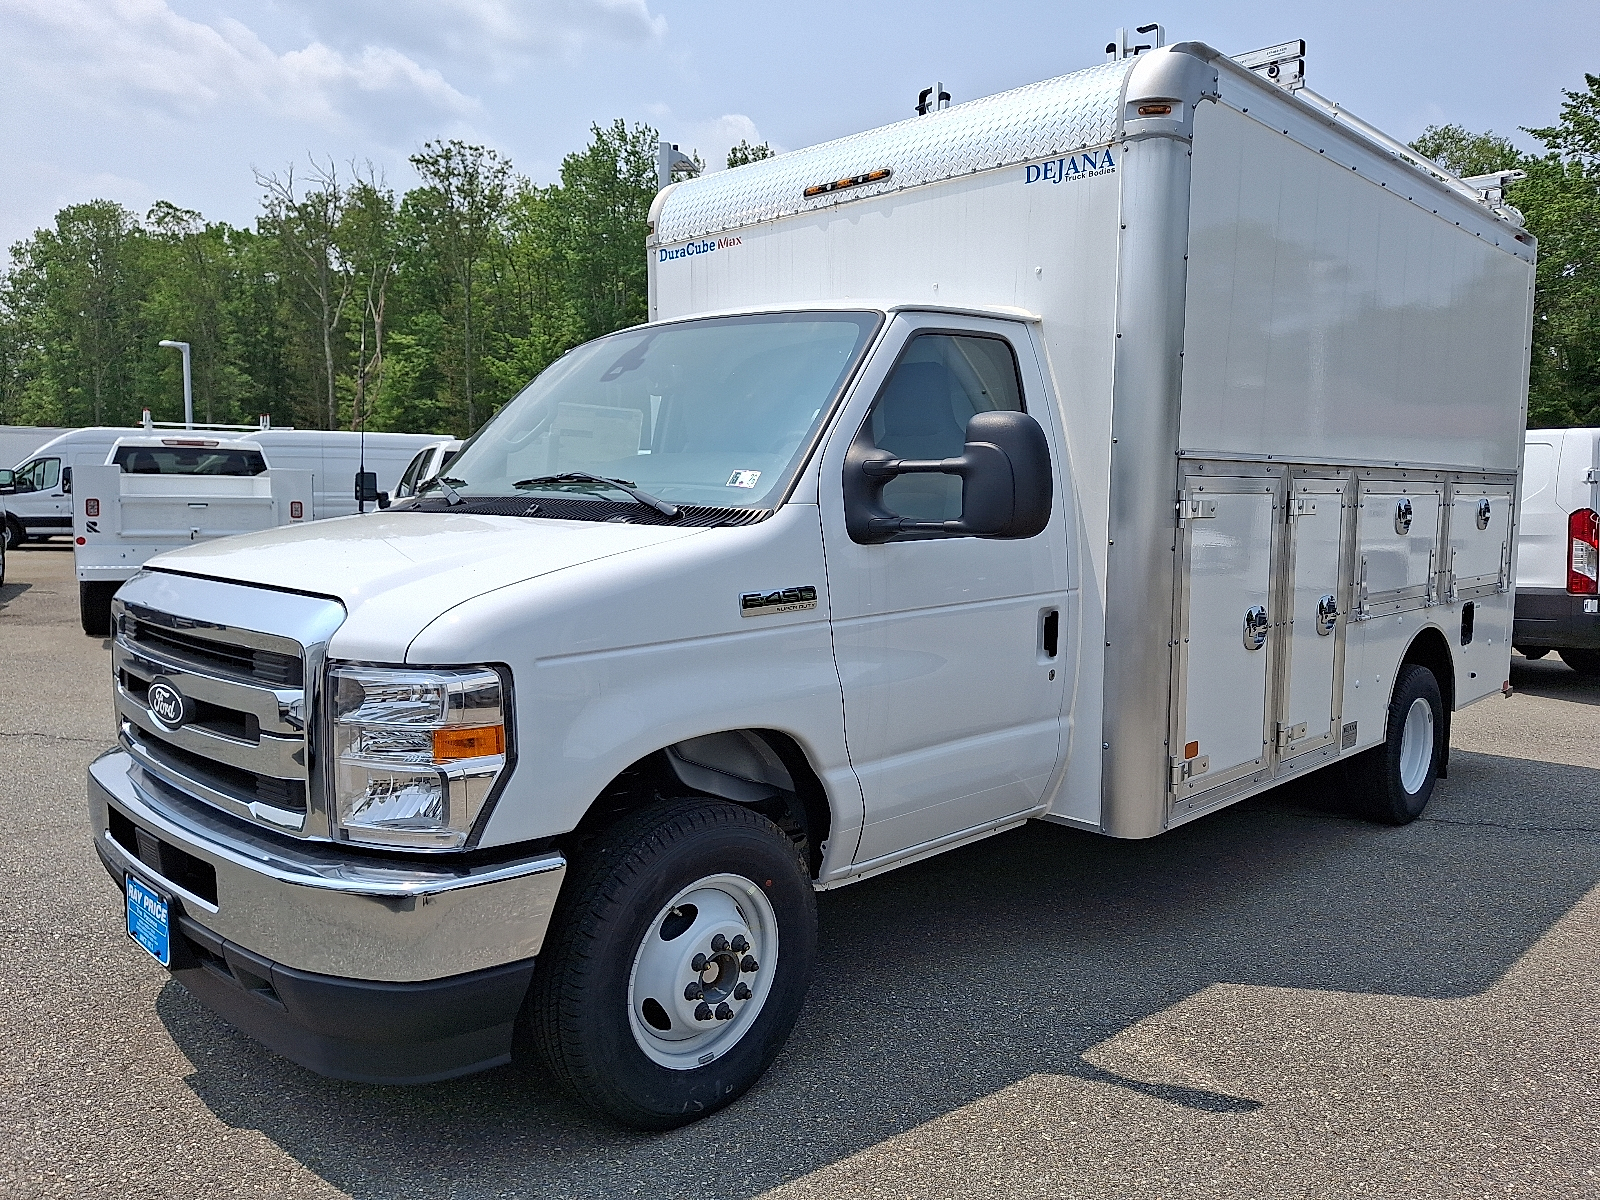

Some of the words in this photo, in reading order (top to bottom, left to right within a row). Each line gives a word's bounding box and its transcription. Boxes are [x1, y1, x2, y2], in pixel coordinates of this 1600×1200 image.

[1024, 148, 1116, 185] DEJANA
[1065, 173, 1086, 183] Truck
[1088, 167, 1116, 178] Bodies
[659, 239, 716, 262] DuraCube
[717, 236, 743, 250] Max
[153, 687, 176, 719] Ford
[128, 883, 143, 905] RAY
[143, 894, 168, 924] PRICE
